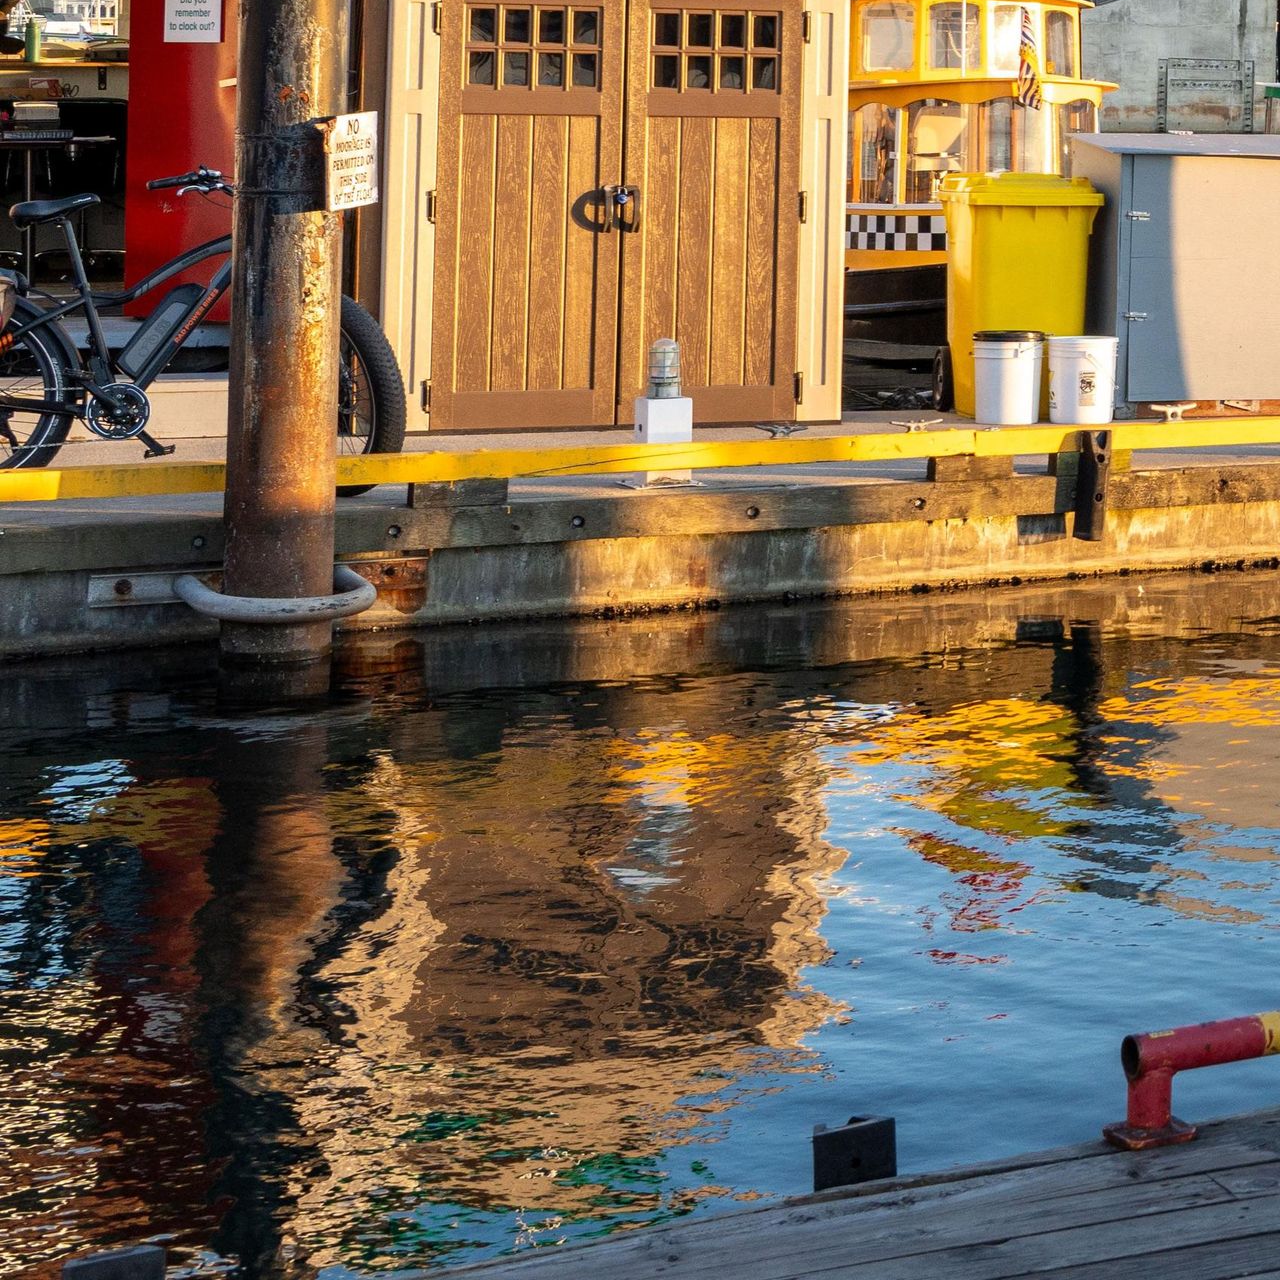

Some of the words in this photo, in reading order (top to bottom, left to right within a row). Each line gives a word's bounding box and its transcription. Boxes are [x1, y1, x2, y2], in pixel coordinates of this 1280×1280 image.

[175, 9, 211, 17] remember
[170, 22, 177, 30] to
[179, 22, 197, 30] clock
[200, 22, 215, 30] out?
[347, 119, 359, 135] NO
[333, 156, 364, 171] PERMITTED
[174, 329, 186, 343] RAD
[203, 288, 219, 308] BIKES
